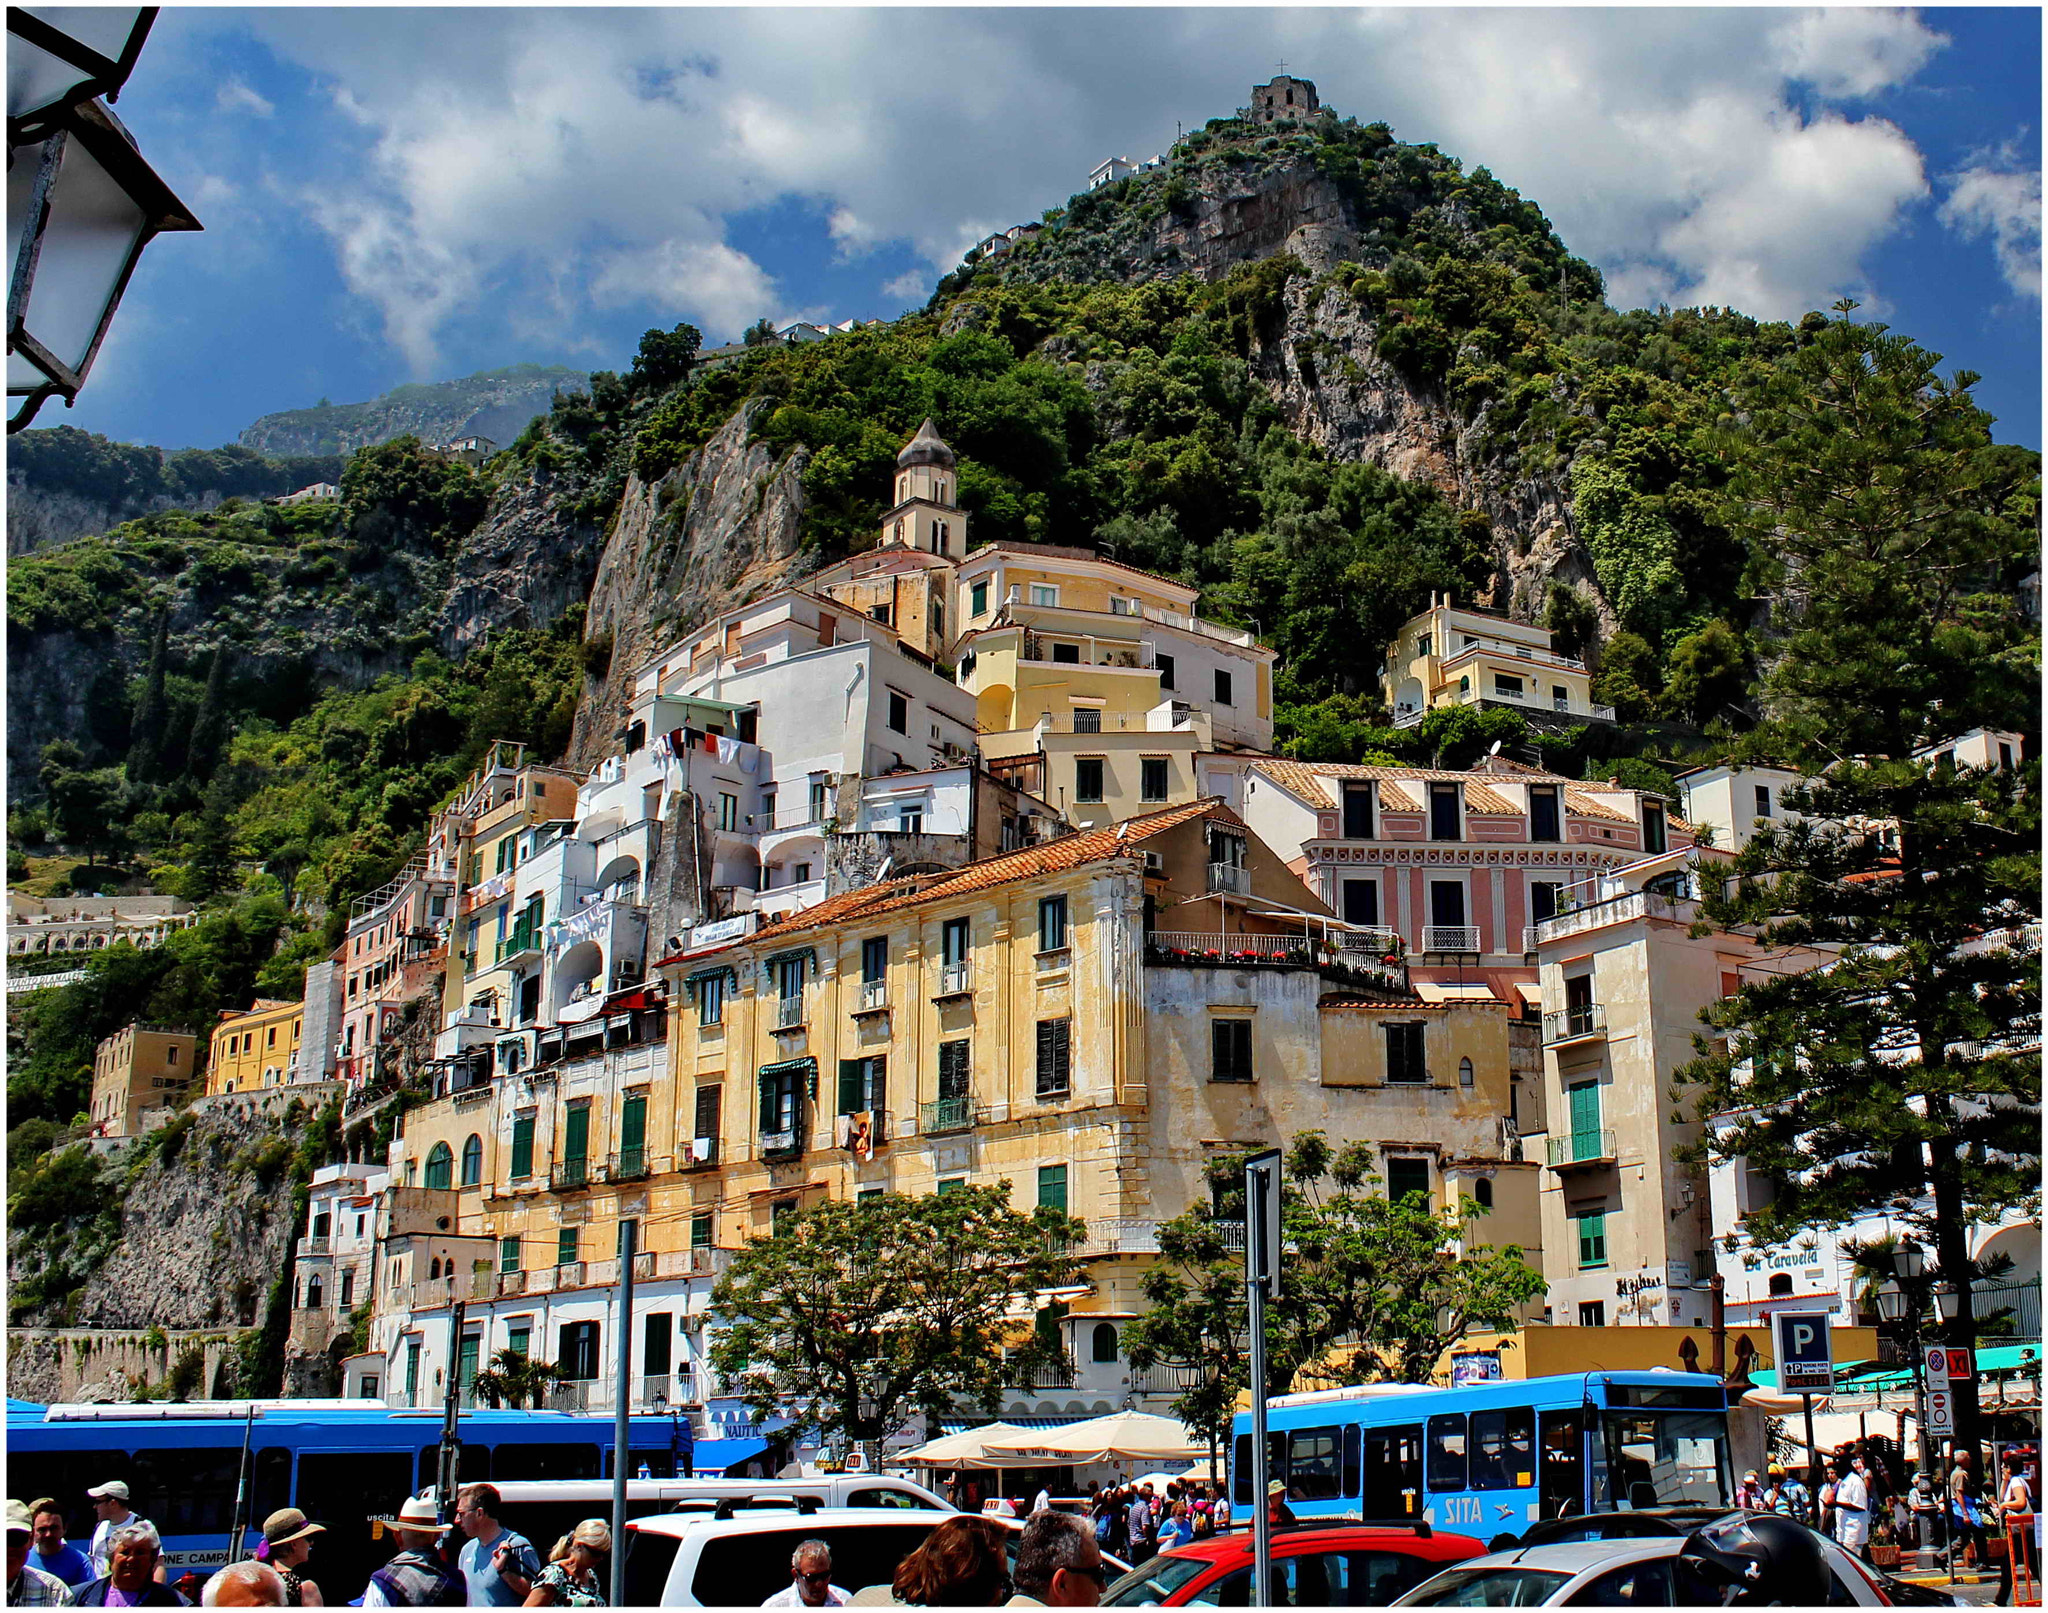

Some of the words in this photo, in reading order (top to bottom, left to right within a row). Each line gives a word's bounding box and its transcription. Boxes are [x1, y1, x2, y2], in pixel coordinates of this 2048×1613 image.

[1767, 1250, 1818, 1269] Caravella
[1793, 1324, 1814, 1355] P
[366, 1513, 395, 1521] uscita
[1445, 1496, 1483, 1524] SITA
